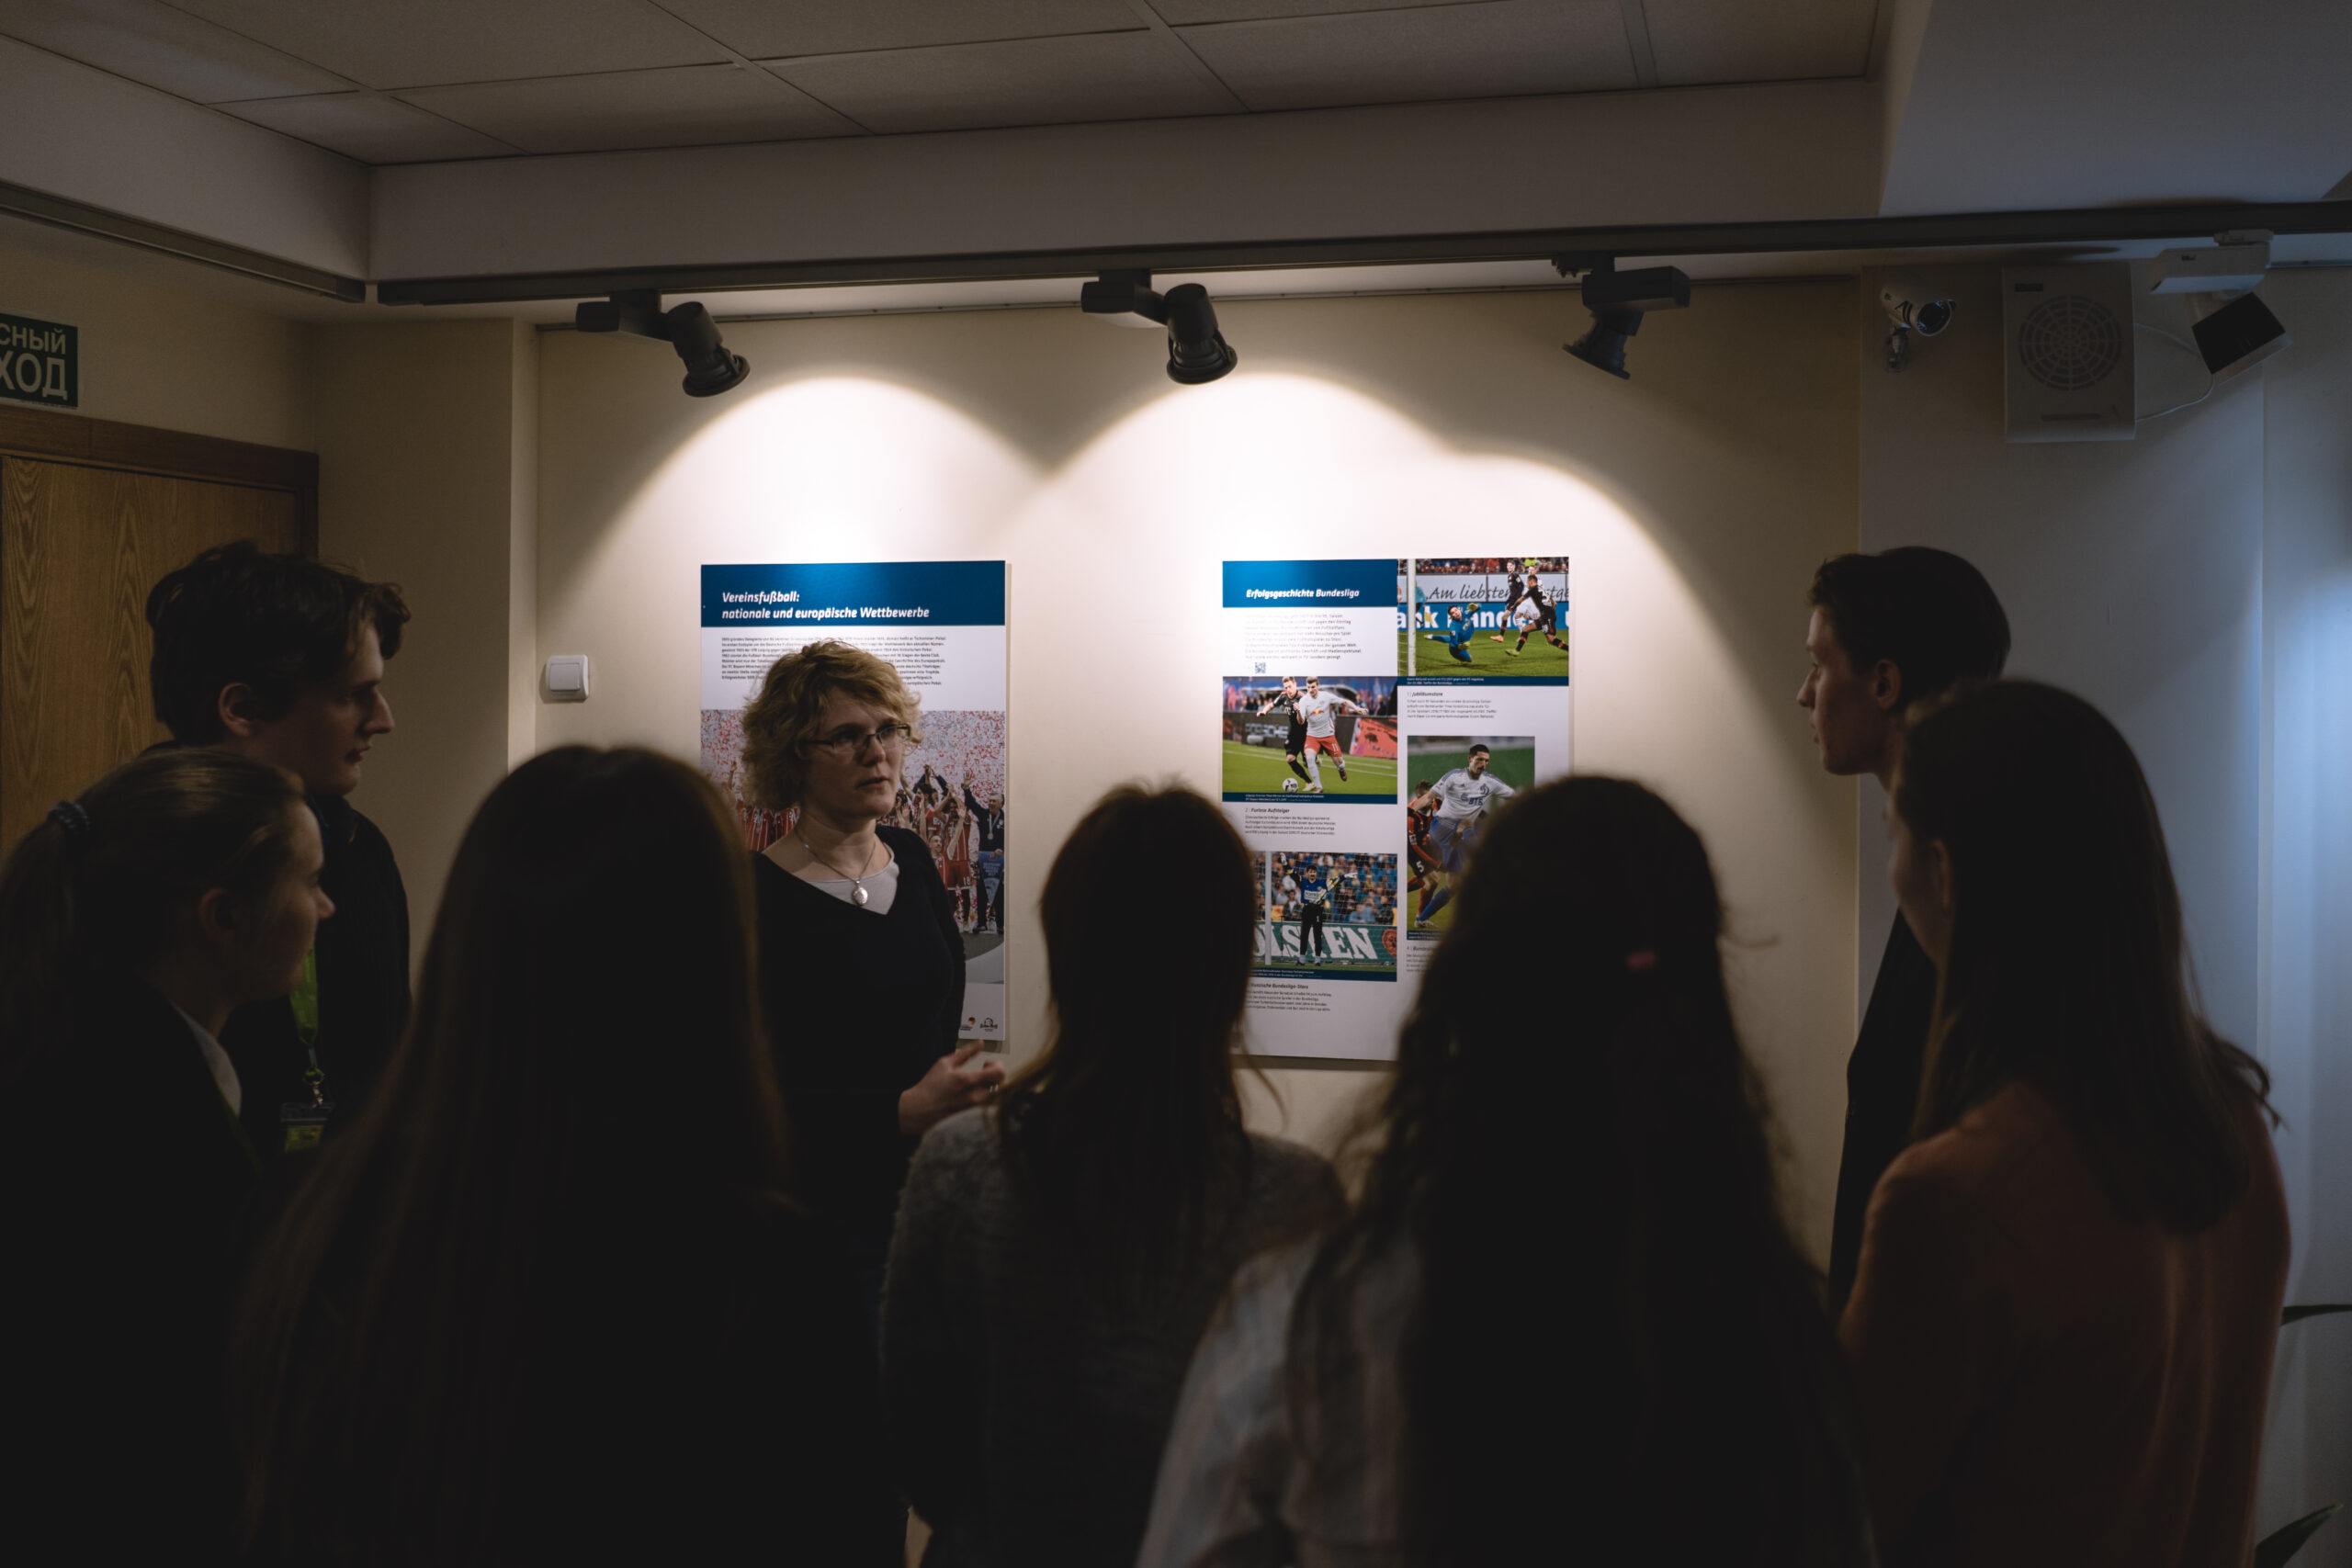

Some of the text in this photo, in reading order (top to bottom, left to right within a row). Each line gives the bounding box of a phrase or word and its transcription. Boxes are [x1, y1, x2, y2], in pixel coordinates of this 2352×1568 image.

[721, 591, 800, 604] Vereinsfußball:
[1246, 588, 1360, 600] Erfolgsgeschichte Bundesliga
[721, 606, 930, 621] nationale und europäische Wettbewerbe
[1416, 861, 1425, 874] 5
